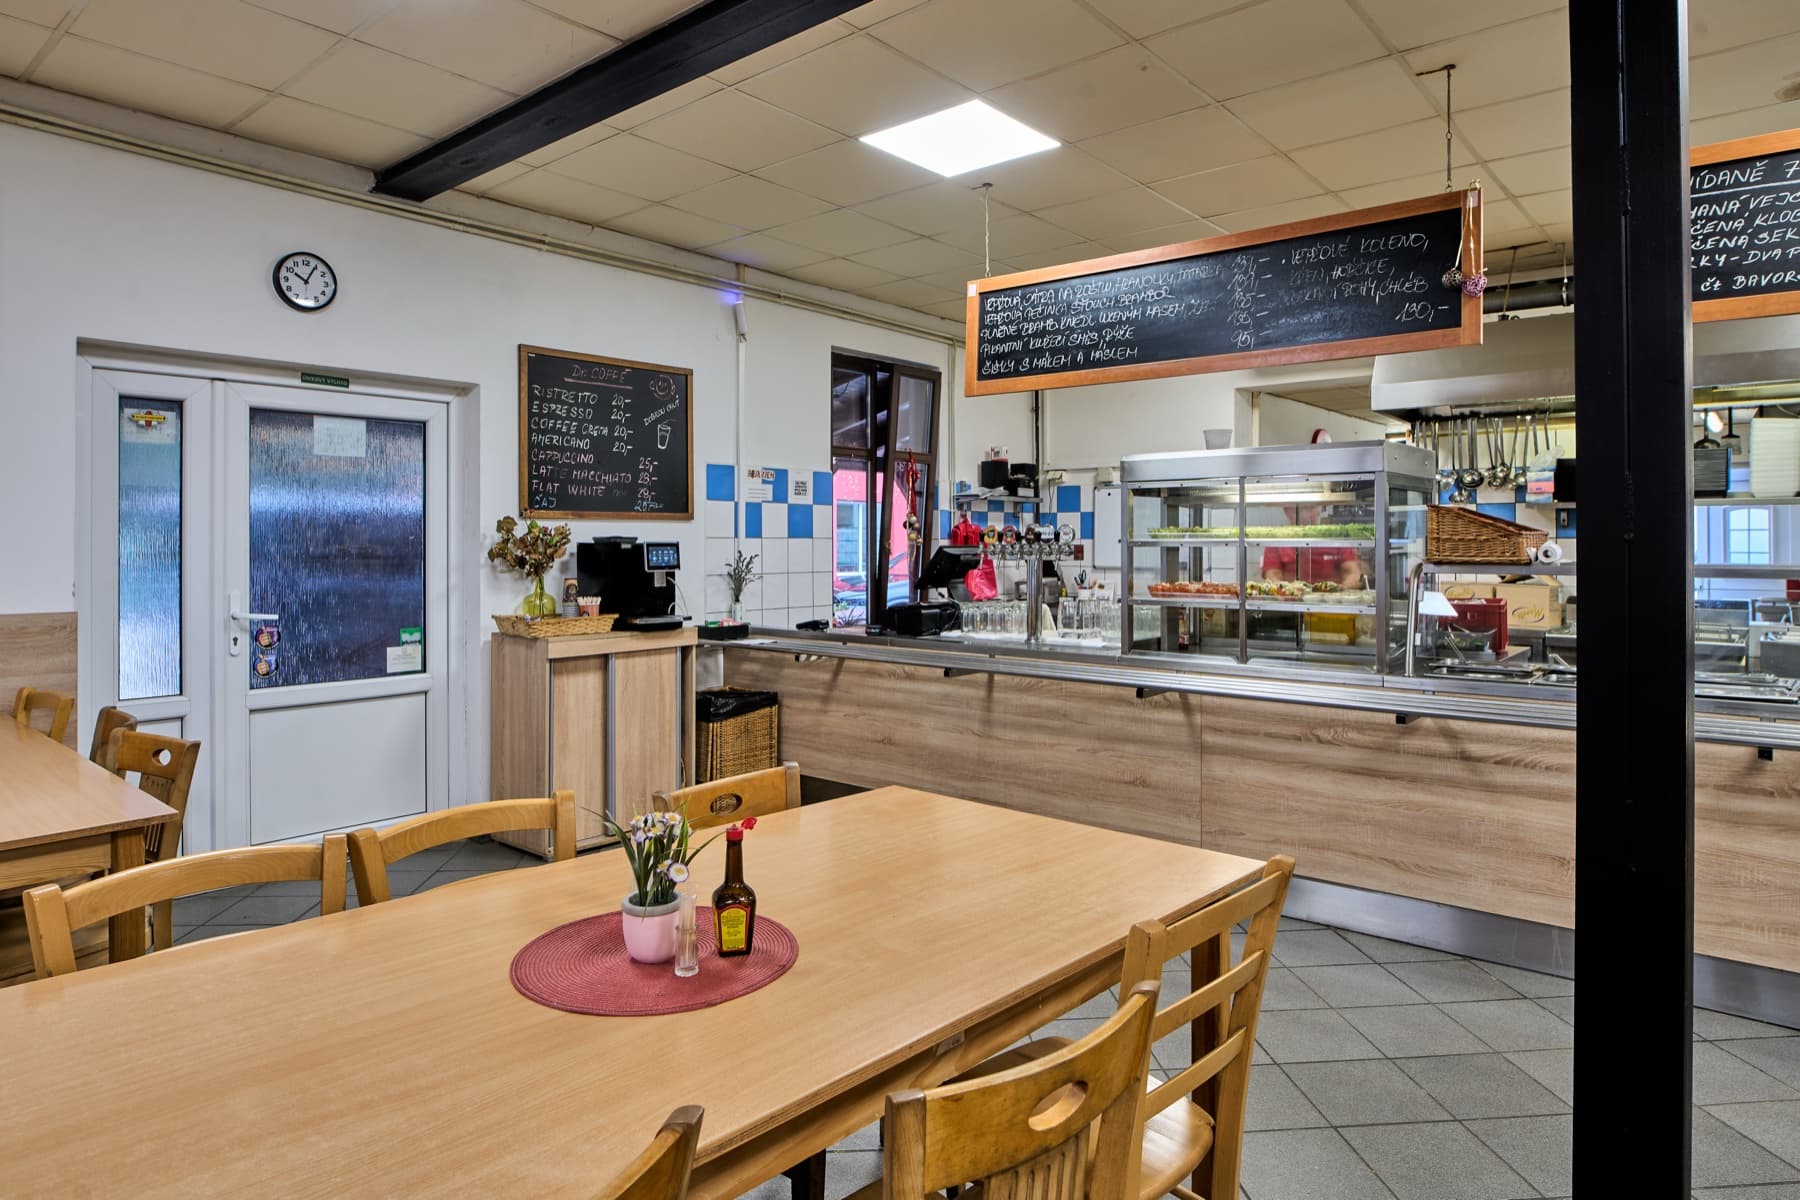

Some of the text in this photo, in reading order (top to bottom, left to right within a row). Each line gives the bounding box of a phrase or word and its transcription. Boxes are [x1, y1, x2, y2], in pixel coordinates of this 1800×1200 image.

[1690, 160, 1768, 190] ÍDANĚ
[286, 266, 294, 274] 10
[302, 259, 311, 267] 12
[1732, 270, 1800, 290] BAVOR
[532, 385, 599, 405] RISTRETTO
[531, 417, 578, 434] COFFEE
[531, 434, 590, 450] AMERICANO
[531, 449, 594, 464] CAPPUCCINO
[572, 470, 632, 484] MACCHIATO
[532, 480, 560, 494] FLAT
[568, 484, 605, 497] WHITE
